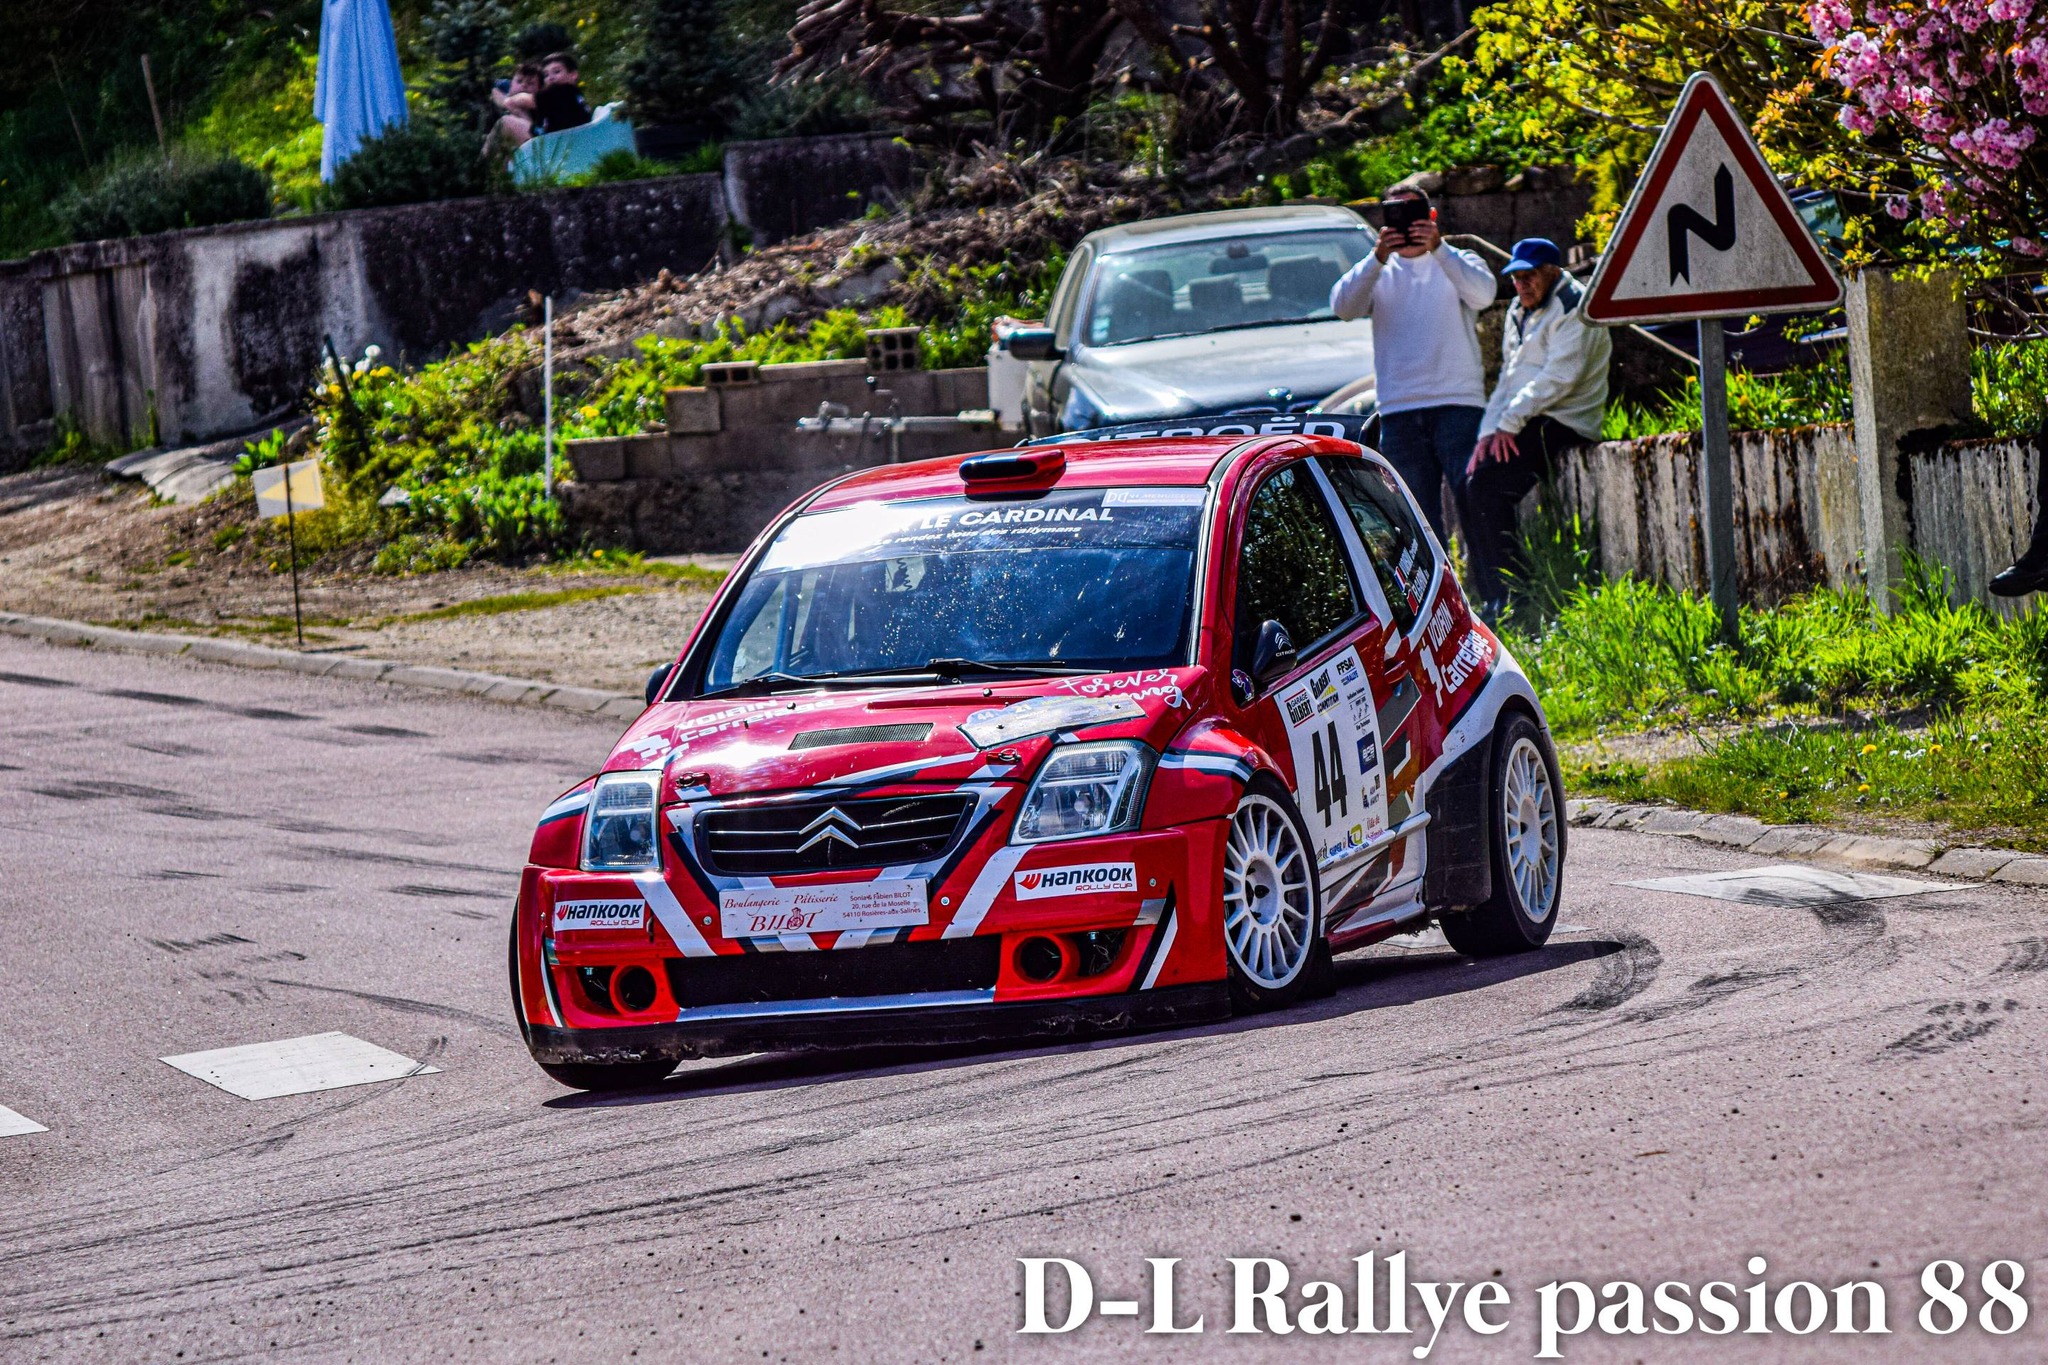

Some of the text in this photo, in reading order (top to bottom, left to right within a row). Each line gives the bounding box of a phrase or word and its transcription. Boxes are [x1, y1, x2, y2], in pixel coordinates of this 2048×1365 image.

[959, 508, 1114, 525] CARDINAL
[895, 533, 943, 543] rendez
[947, 529, 979, 538] vous
[982, 527, 1008, 535] des
[1011, 526, 1081, 535] rallymans
[1441, 629, 1493, 693] Carrelage
[1291, 691, 1308, 707] GARAGE
[1286, 699, 1313, 724] GILBERT
[1312, 721, 1347, 828] 44
[724, 894, 781, 916] Boulangerie
[793, 894, 839, 904] Pâtisserie
